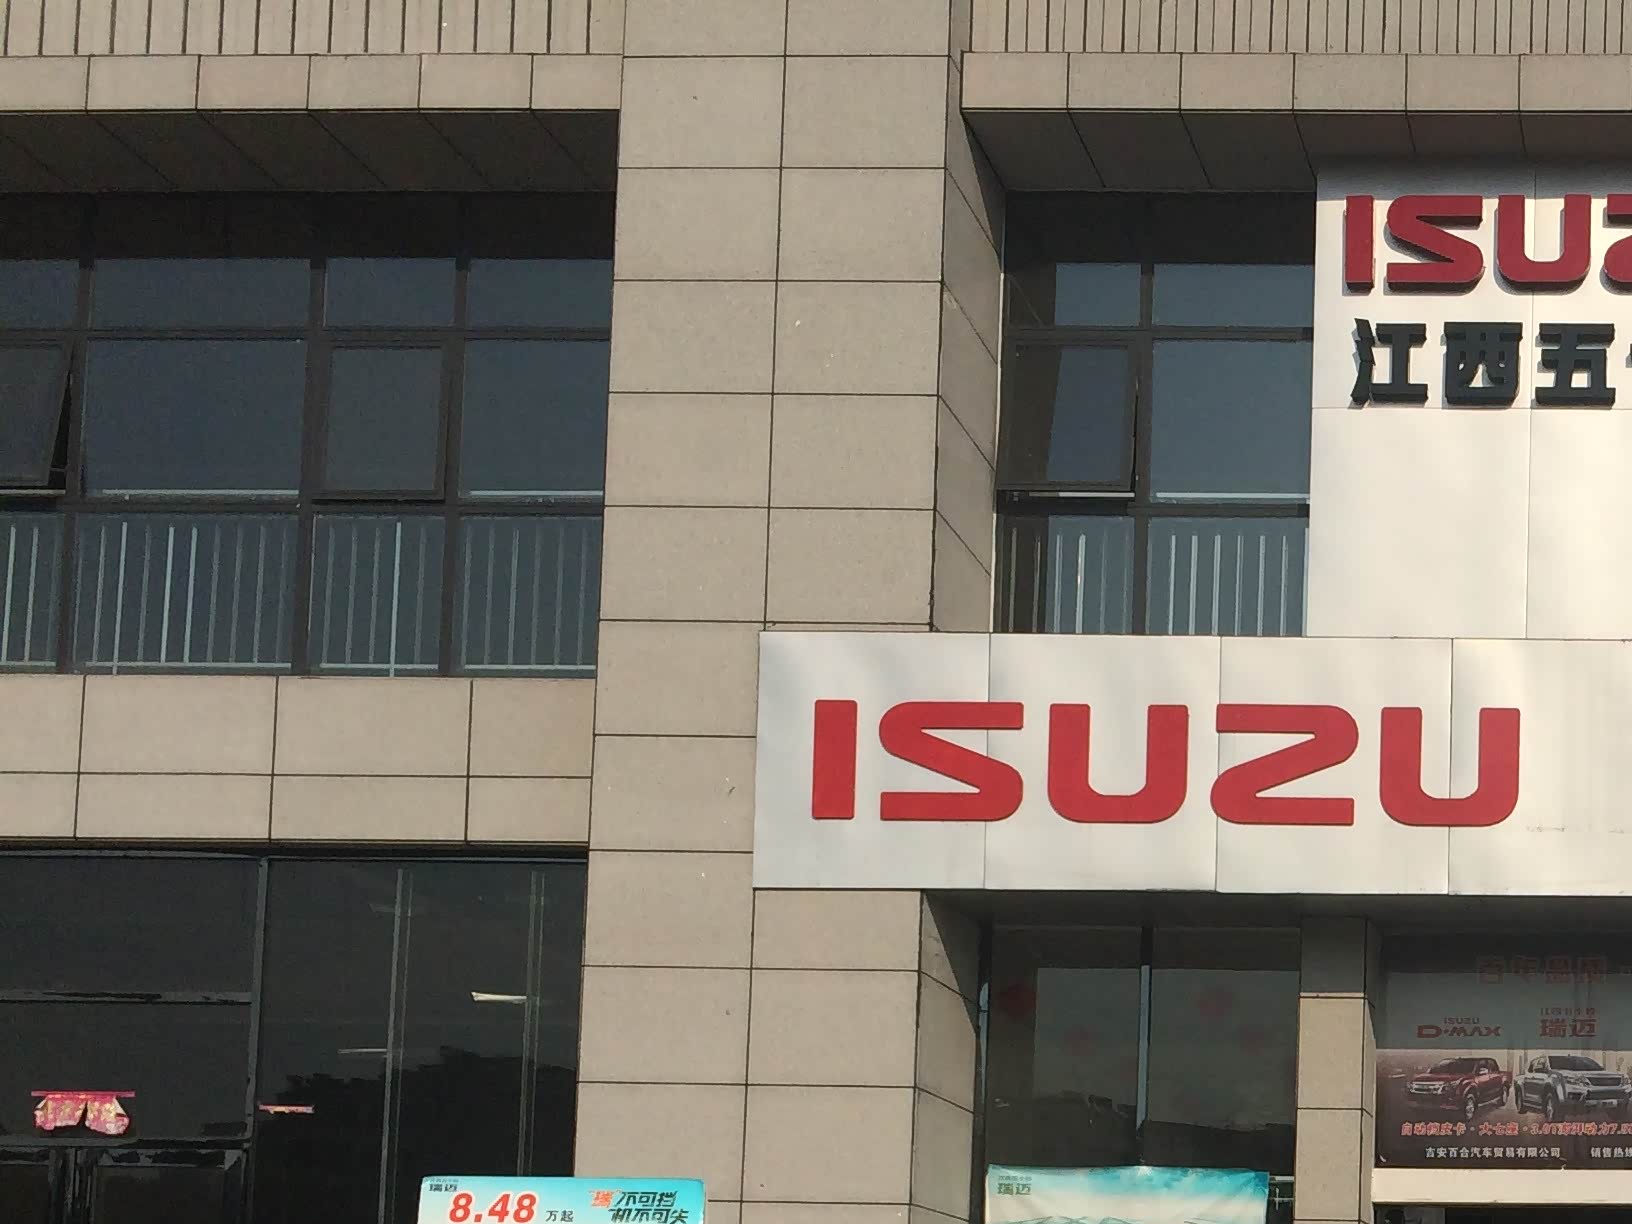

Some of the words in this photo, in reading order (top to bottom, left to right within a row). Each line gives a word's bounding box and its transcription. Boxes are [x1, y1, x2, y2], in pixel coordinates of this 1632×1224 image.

[811, 698, 1521, 828] ISUZU
[1443, 1017, 1480, 1025] ISUZU
[1539, 1017, 1598, 1038] 瑞迈
[1425, 1146, 1562, 1159] 吉安百合汽车贸易有限公司
[997, 1182, 1032, 1196] 瑞迈
[448, 1192, 538, 1224] 8.48
[545, 1209, 574, 1223] 万起
